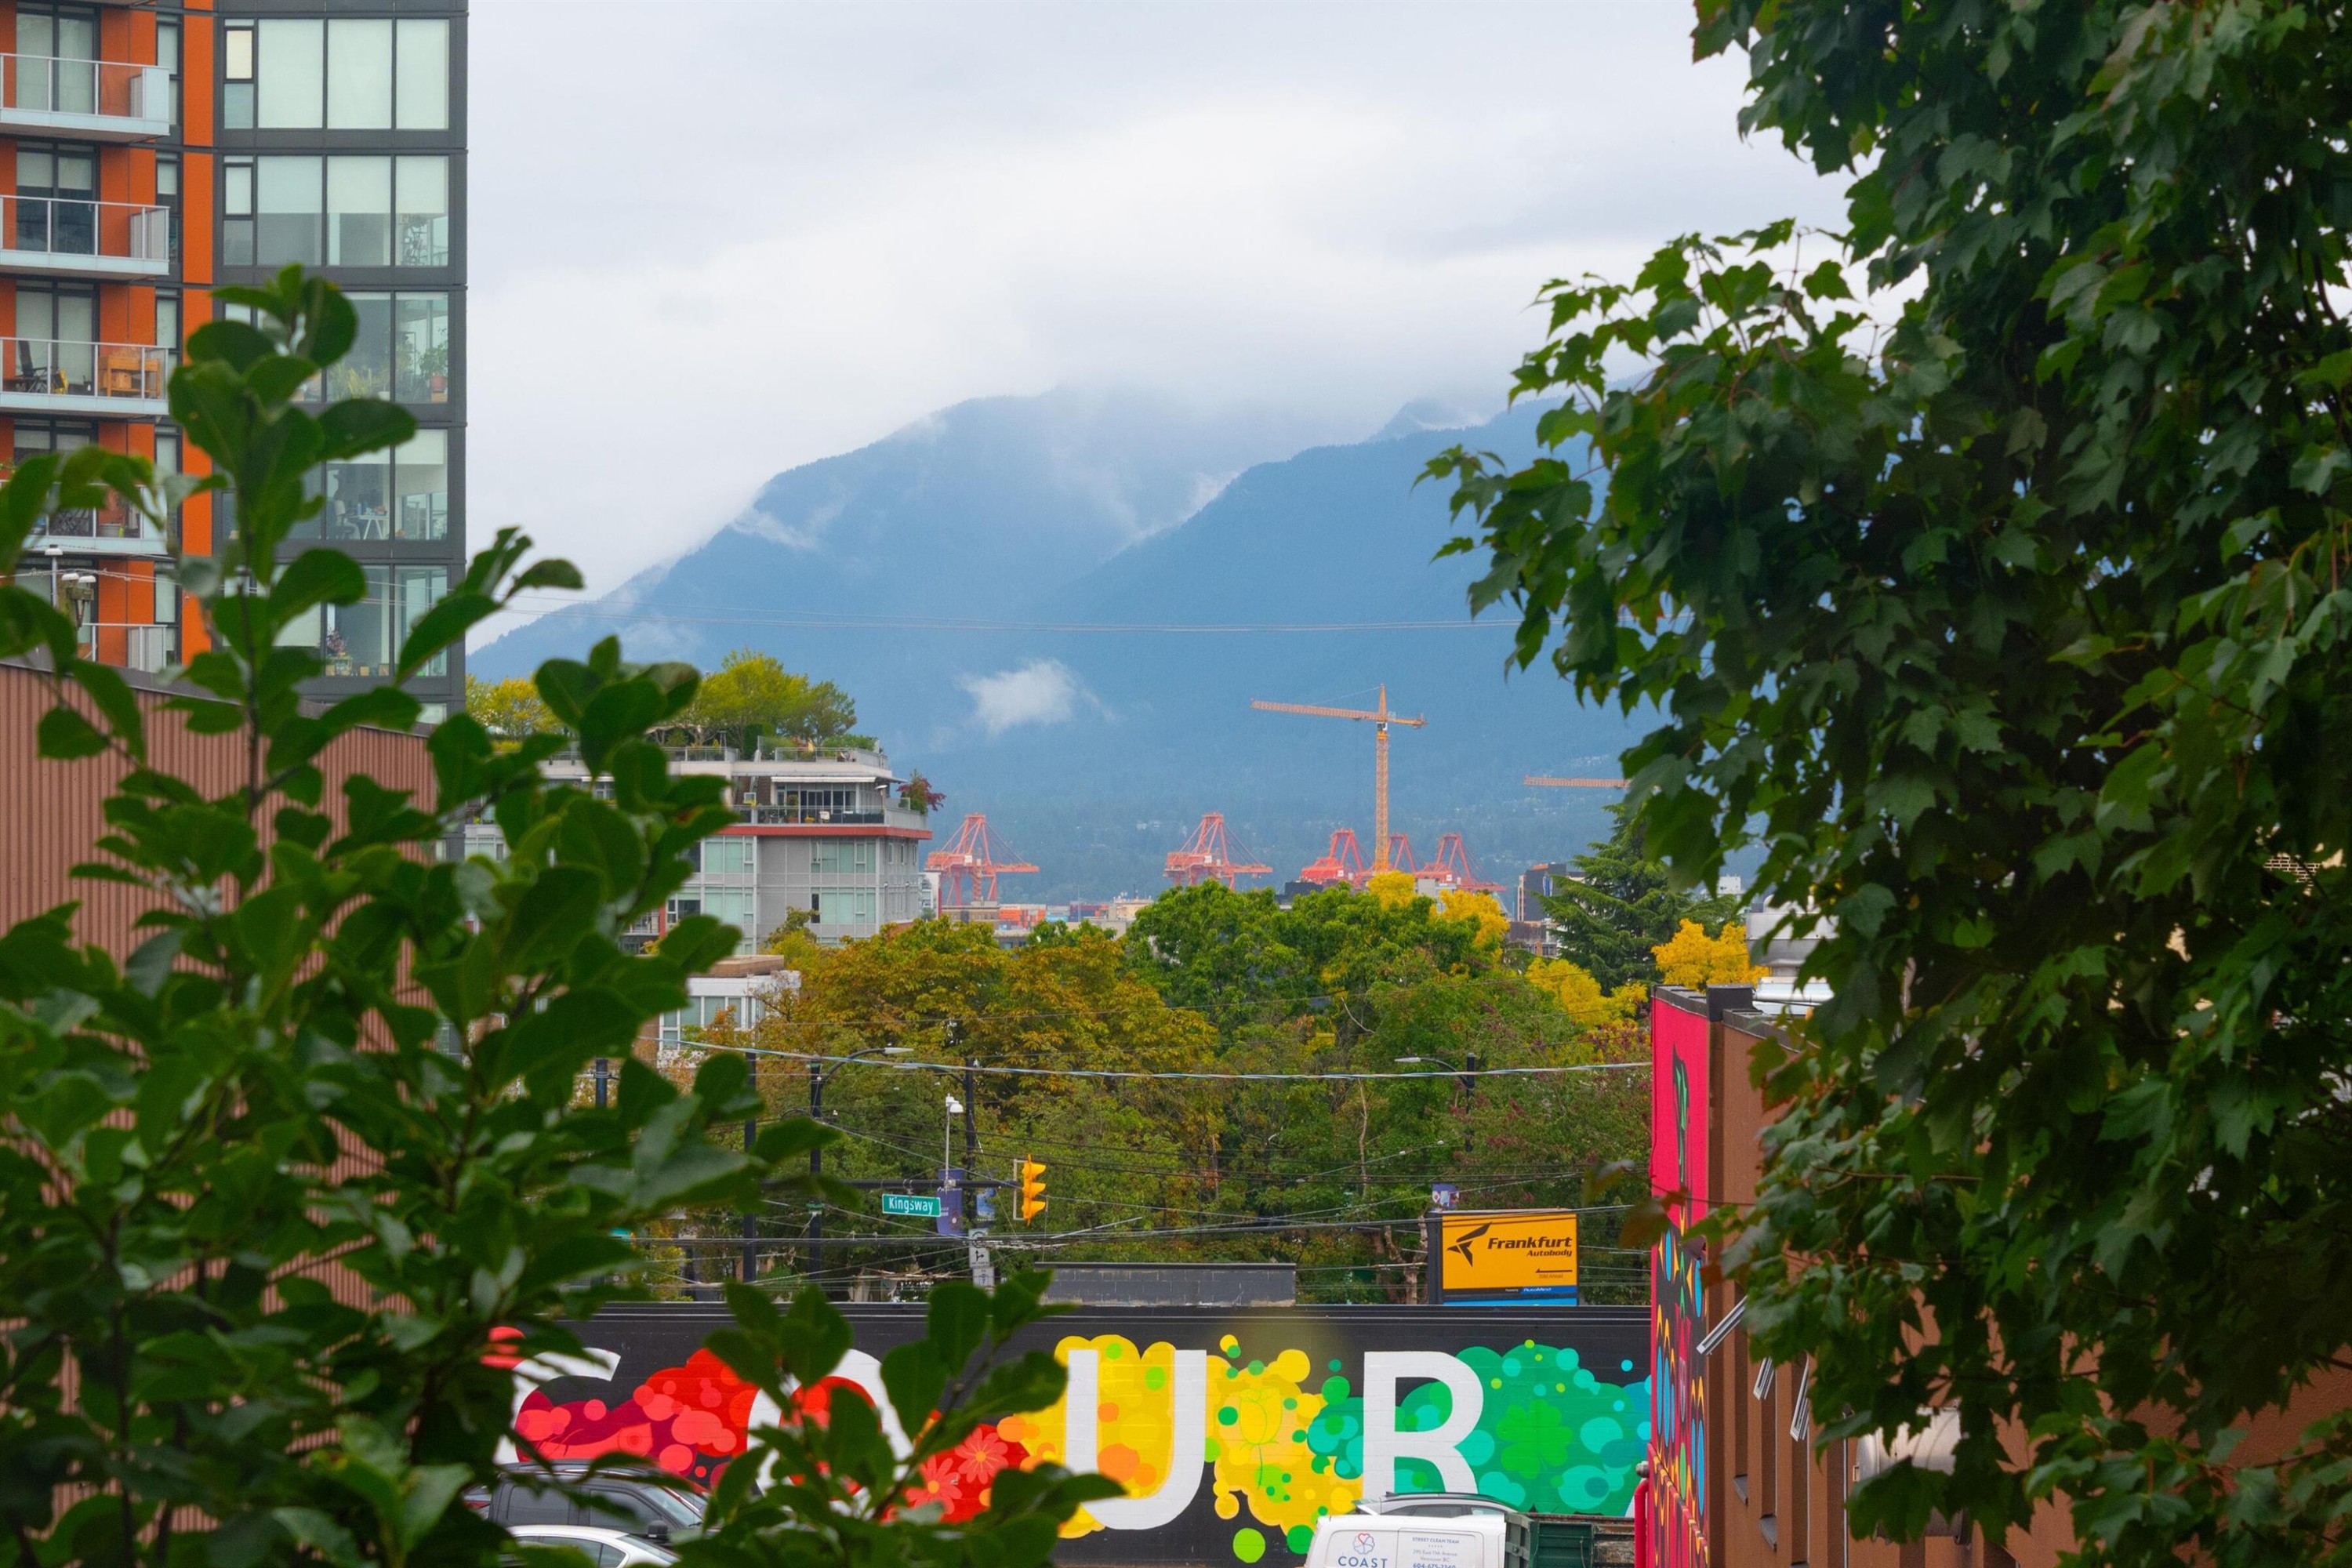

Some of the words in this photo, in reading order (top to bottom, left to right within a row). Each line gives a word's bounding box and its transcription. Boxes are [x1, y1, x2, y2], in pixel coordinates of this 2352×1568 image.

[889, 1197, 934, 1214] Kingsway
[1487, 1236, 1573, 1250] Frankfurt
[1338, 1555, 1388, 1568] COAST
